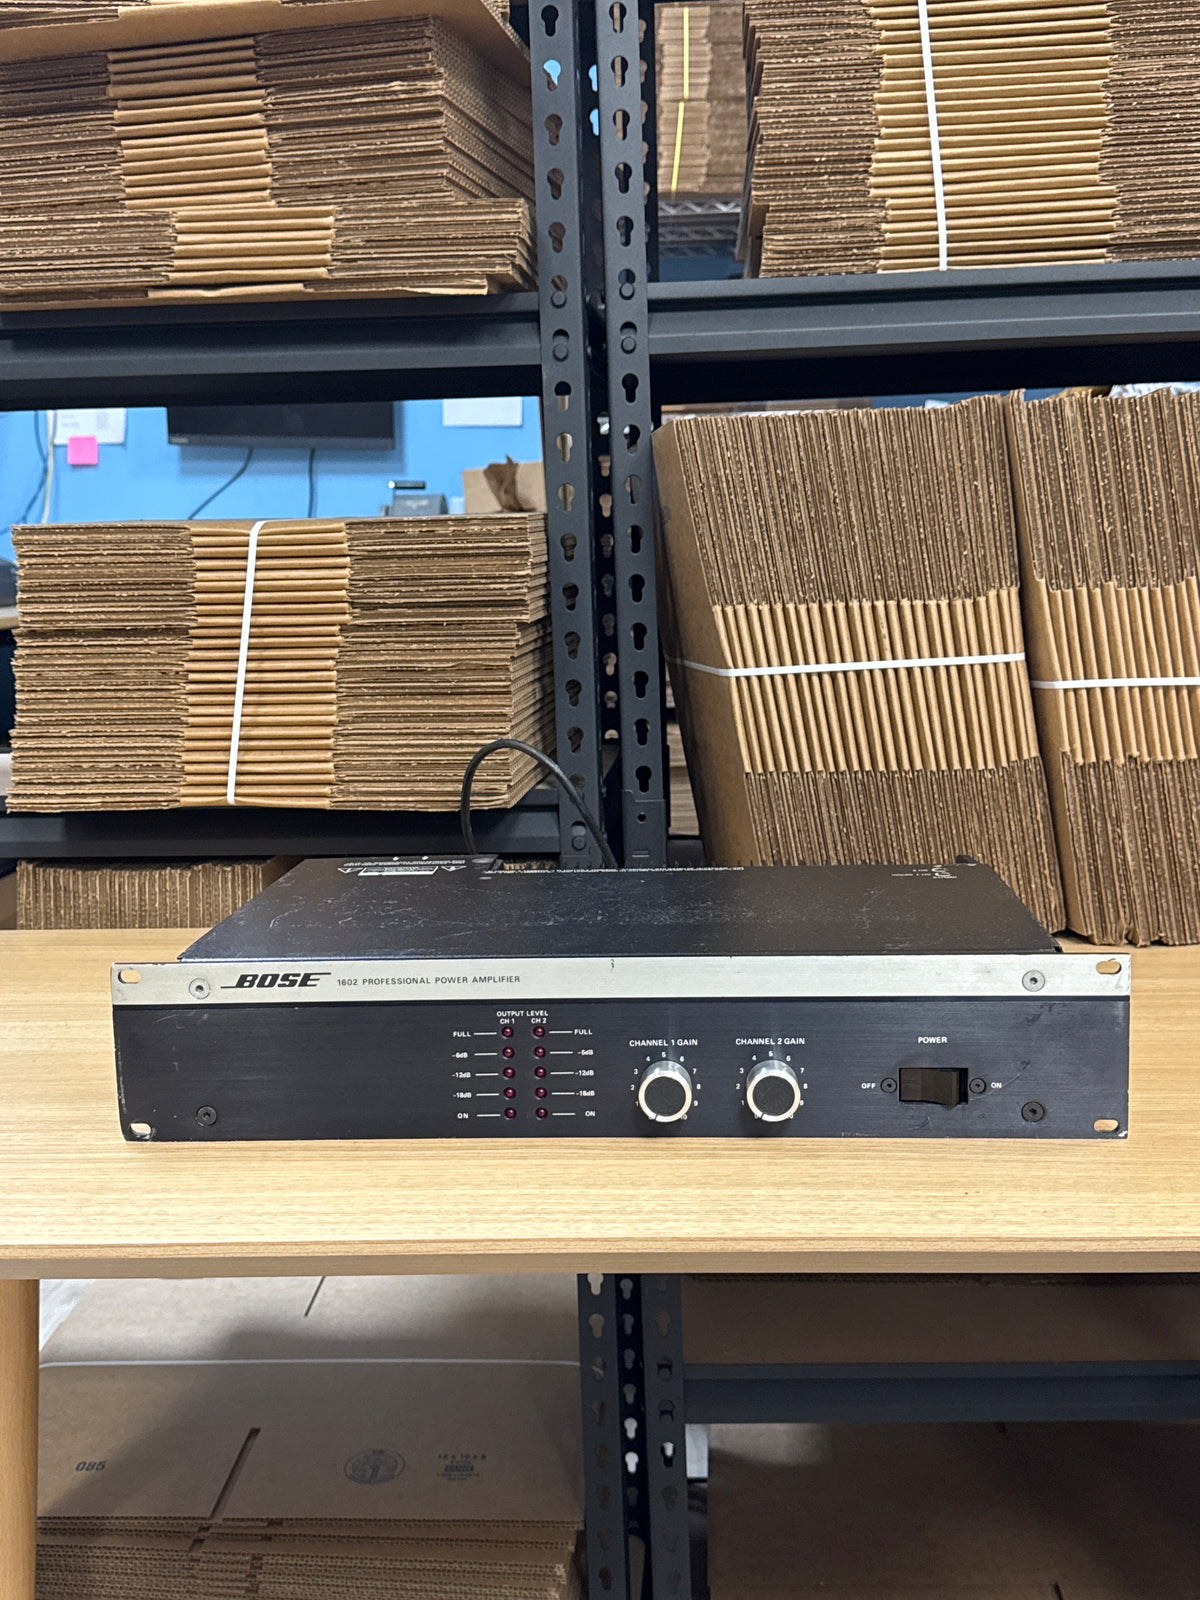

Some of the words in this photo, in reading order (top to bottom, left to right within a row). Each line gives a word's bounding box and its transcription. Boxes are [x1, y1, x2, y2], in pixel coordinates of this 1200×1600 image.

[220, 972, 331, 989] BOSE
[362, 977, 431, 985] PROFESSIONAL
[435, 976, 468, 984] POWER
[472, 975, 520, 983] AMPLIFIER
[629, 1039, 669, 1047] CHANNEL
